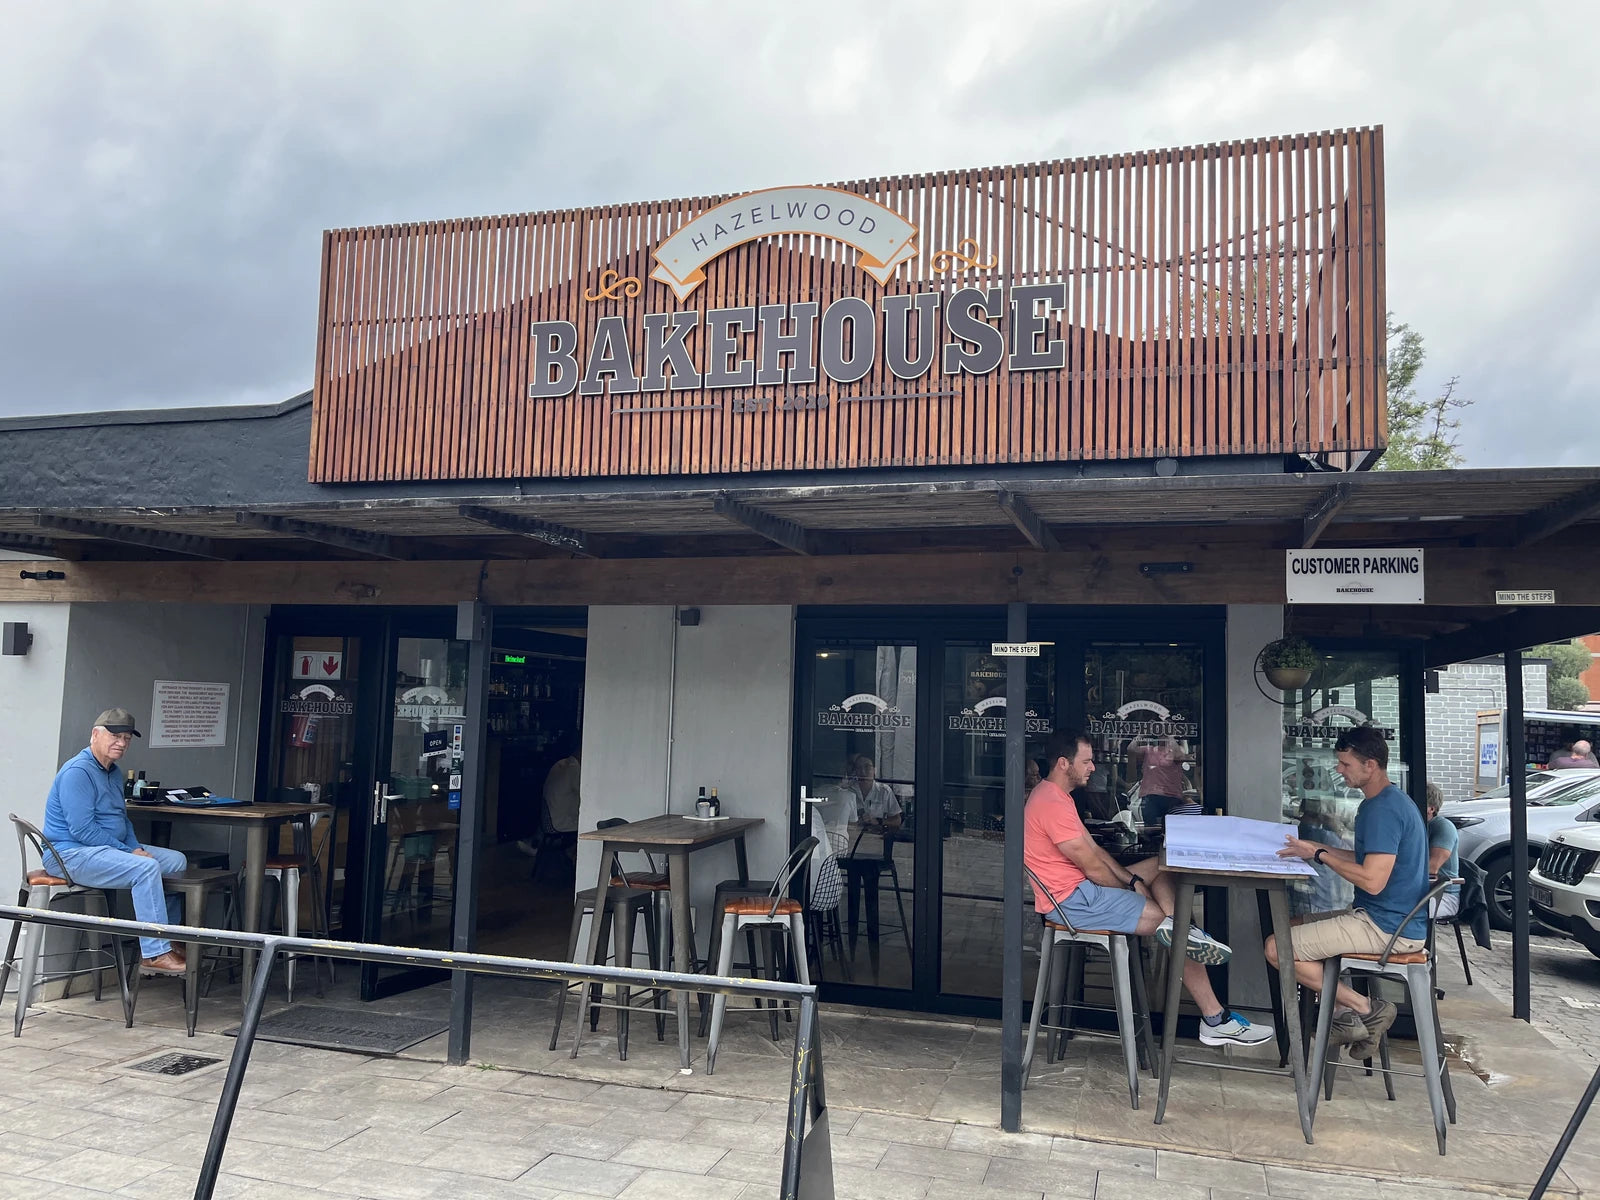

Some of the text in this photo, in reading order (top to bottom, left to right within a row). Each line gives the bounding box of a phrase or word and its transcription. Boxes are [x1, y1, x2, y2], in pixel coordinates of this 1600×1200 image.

[691, 202, 876, 251] HAZELWOOD
[529, 282, 1067, 398] BAKEHOUSE
[1292, 556, 1419, 574] CUSTOMER PARKING
[1499, 592, 1552, 601] MIND THE STEPS
[280, 700, 353, 714] BAKEHOUSE
[818, 712, 911, 728] BAKEHOUSE
[949, 716, 1050, 733] BAKEHSE
[1090, 720, 1198, 737] BAKEHOUSE
[429, 739, 442, 747] OPEN
